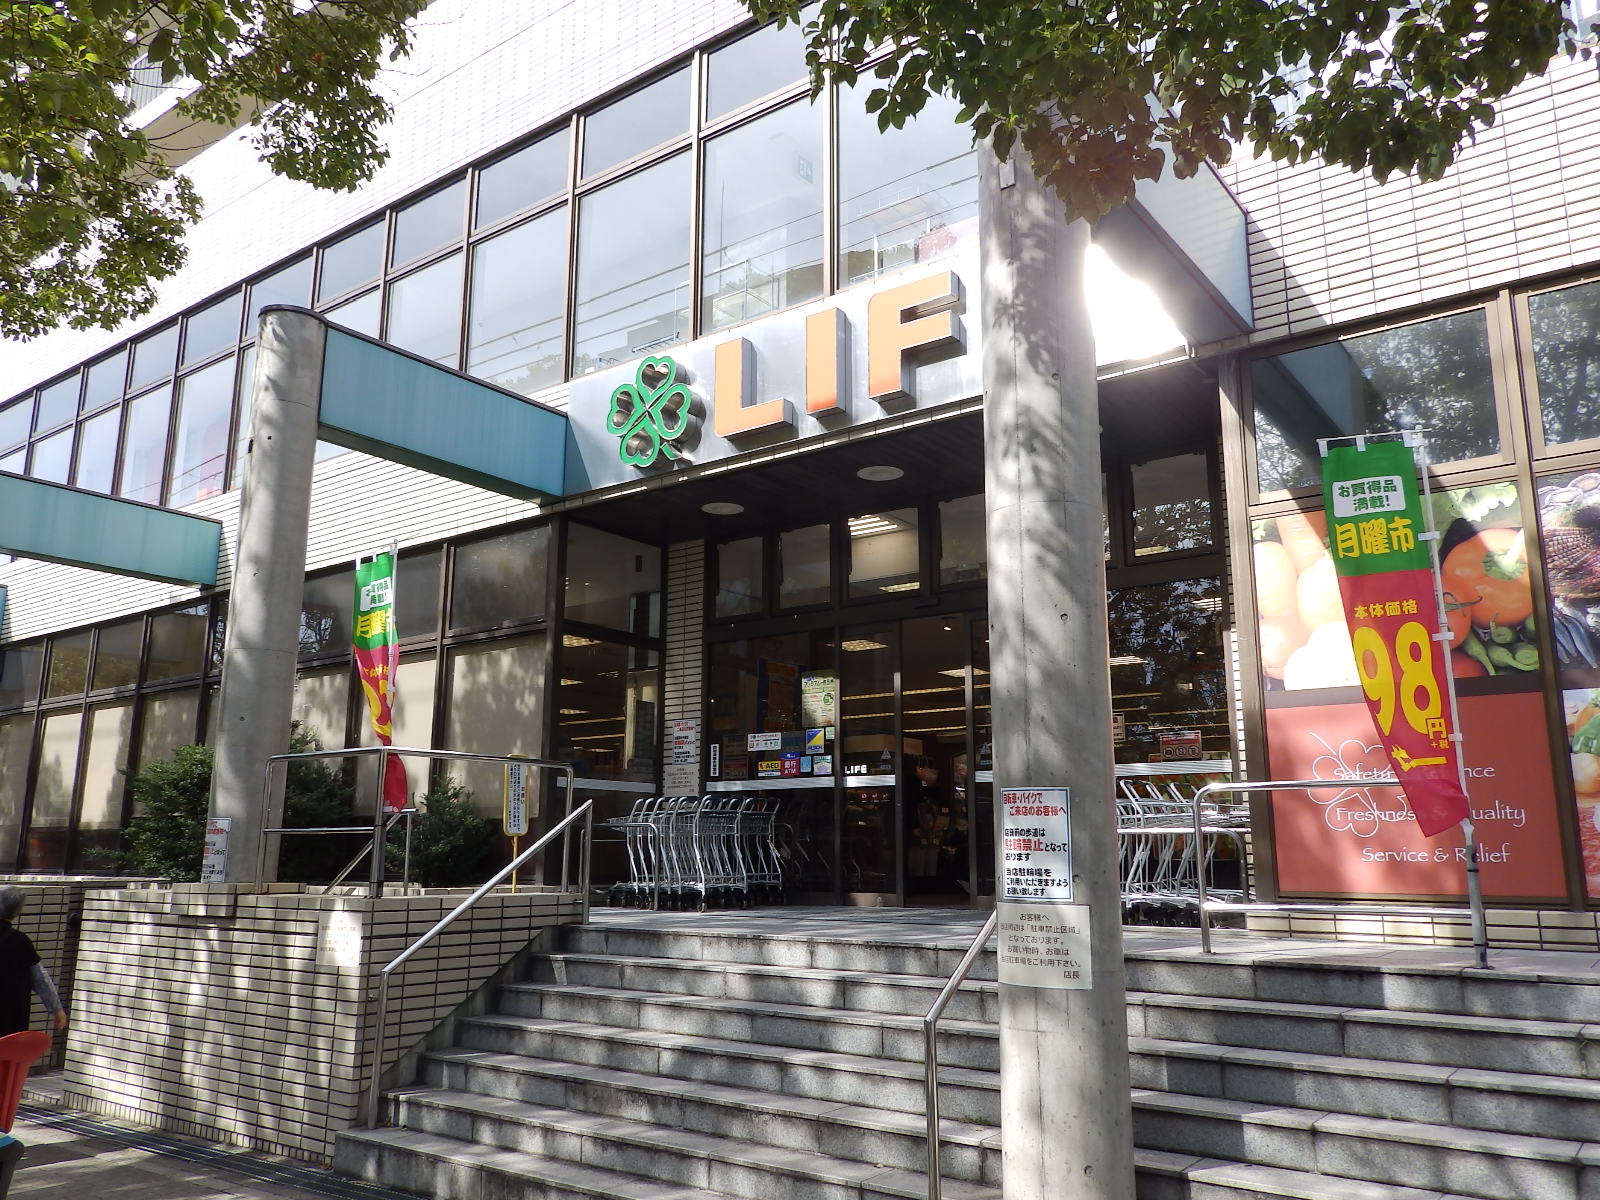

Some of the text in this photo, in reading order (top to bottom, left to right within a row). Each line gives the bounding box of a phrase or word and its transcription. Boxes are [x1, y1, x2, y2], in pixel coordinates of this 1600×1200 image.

[714, 269, 965, 438] LIF
[1338, 479, 1397, 499] お買得品
[1353, 494, 1391, 512] 満載!
[1335, 516, 1414, 559] 月曜市
[1354, 599, 1418, 620] 本体価格
[1353, 621, 1442, 737] 98
[1426, 717, 1447, 740] 円
[844, 764, 868, 774] LIFE
[1009, 805, 1067, 817] ご来店のお客様へ
[1005, 853, 1032, 861] おります
[1361, 847, 1428, 862] Service
[1434, 849, 1449, 862] &
[1006, 867, 1052, 877] 当店駐輪場を
[1006, 877, 1069, 887] ご利用いただきますよう
[1006, 887, 1046, 896] お願い致します
[1020, 913, 1050, 922] お客様へ
[1063, 971, 1080, 980] 店長
